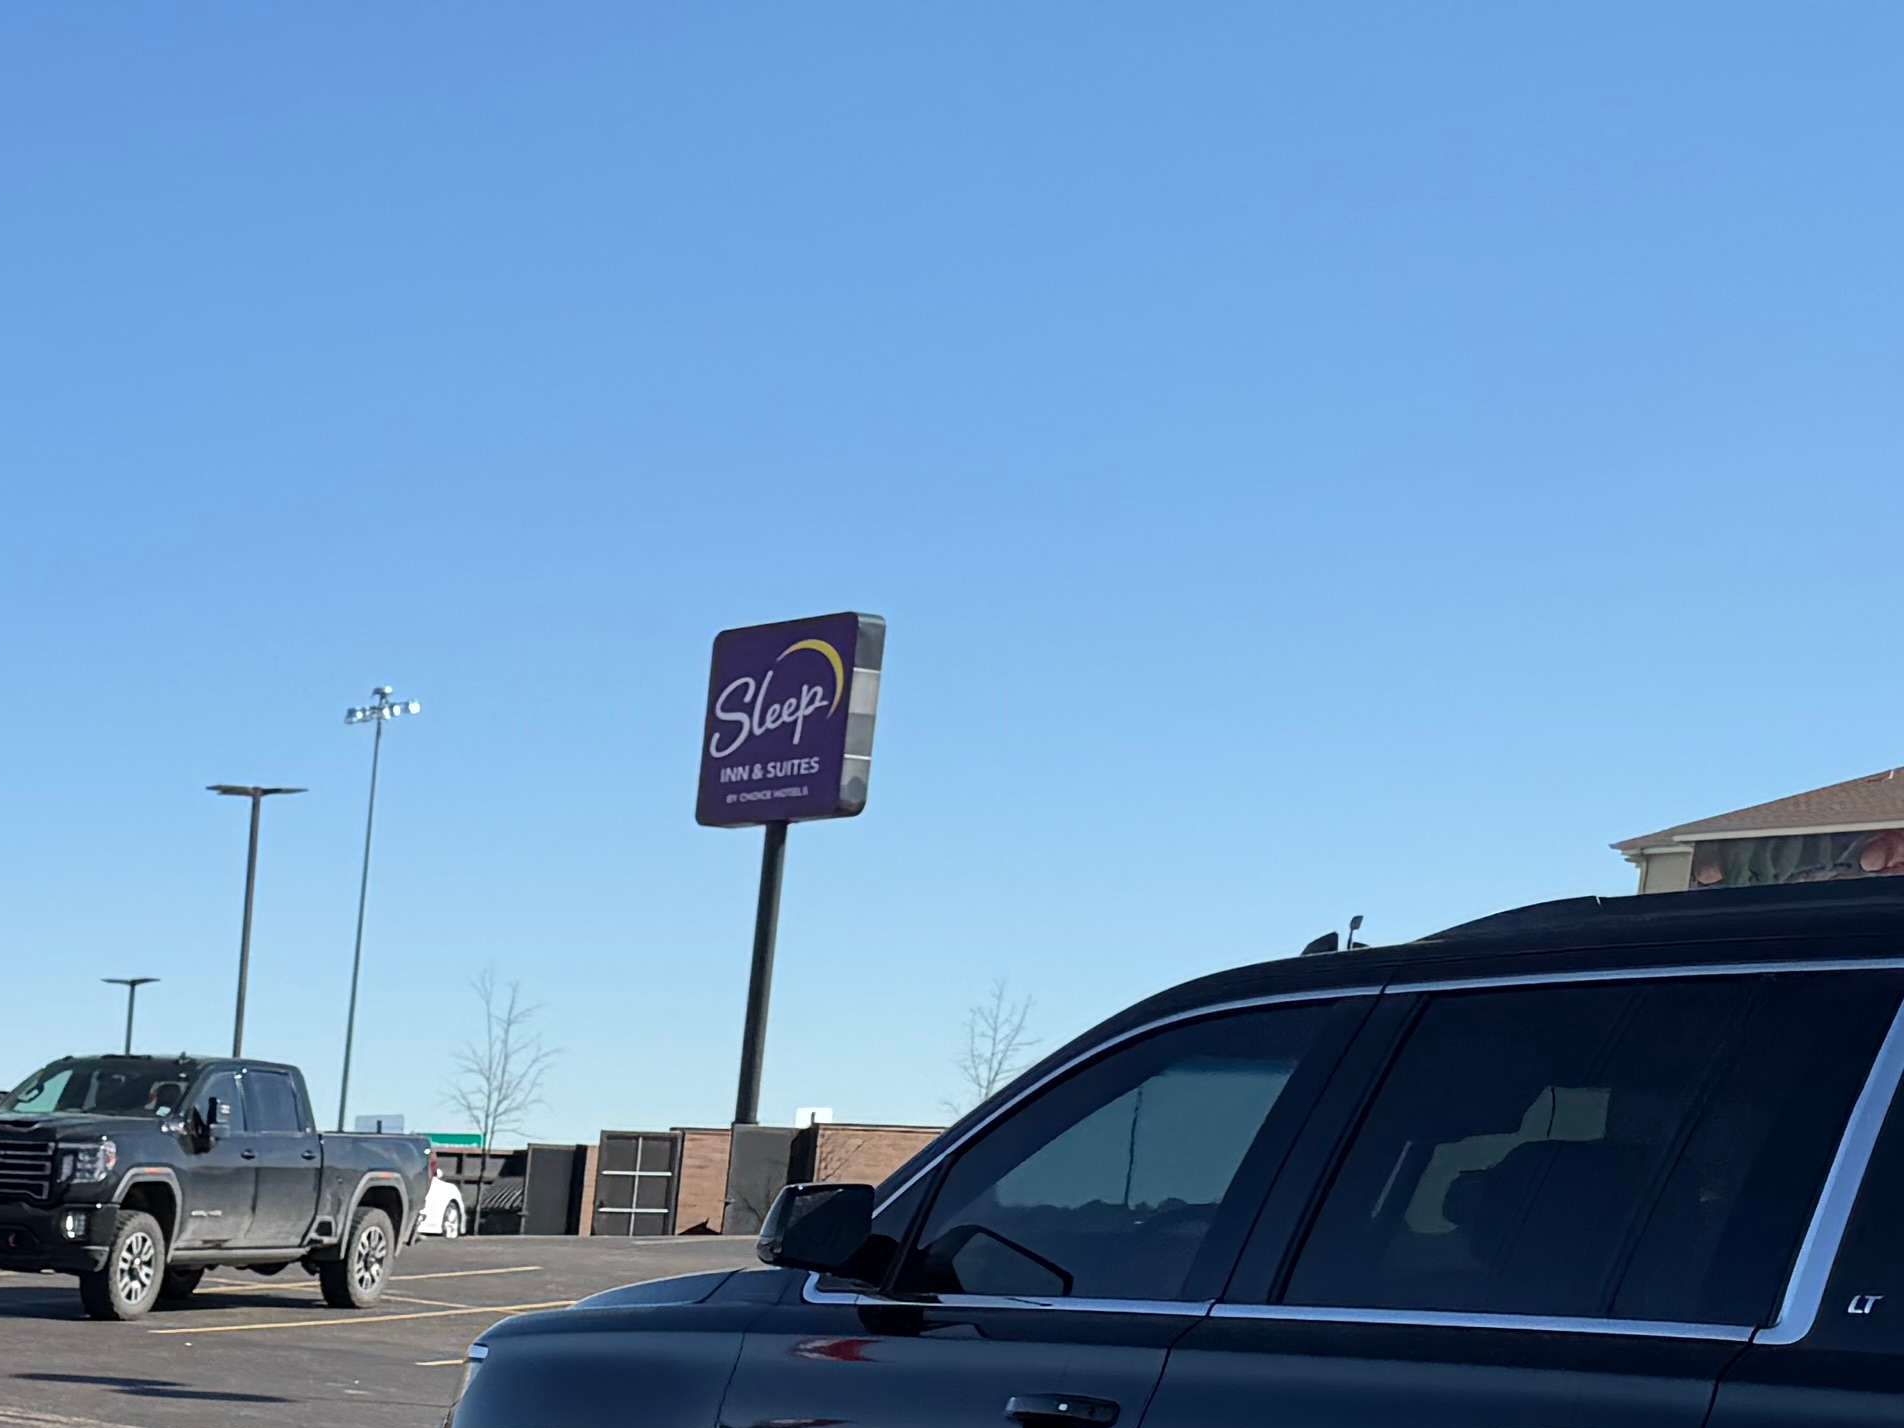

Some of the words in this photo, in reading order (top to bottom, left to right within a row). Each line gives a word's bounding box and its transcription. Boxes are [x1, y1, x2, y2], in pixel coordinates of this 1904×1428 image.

[709, 669, 830, 759] Sleep
[720, 765, 750, 783] INN
[751, 763, 764, 780] &
[766, 756, 821, 778] SUITES
[1847, 1295, 1885, 1314] LT
